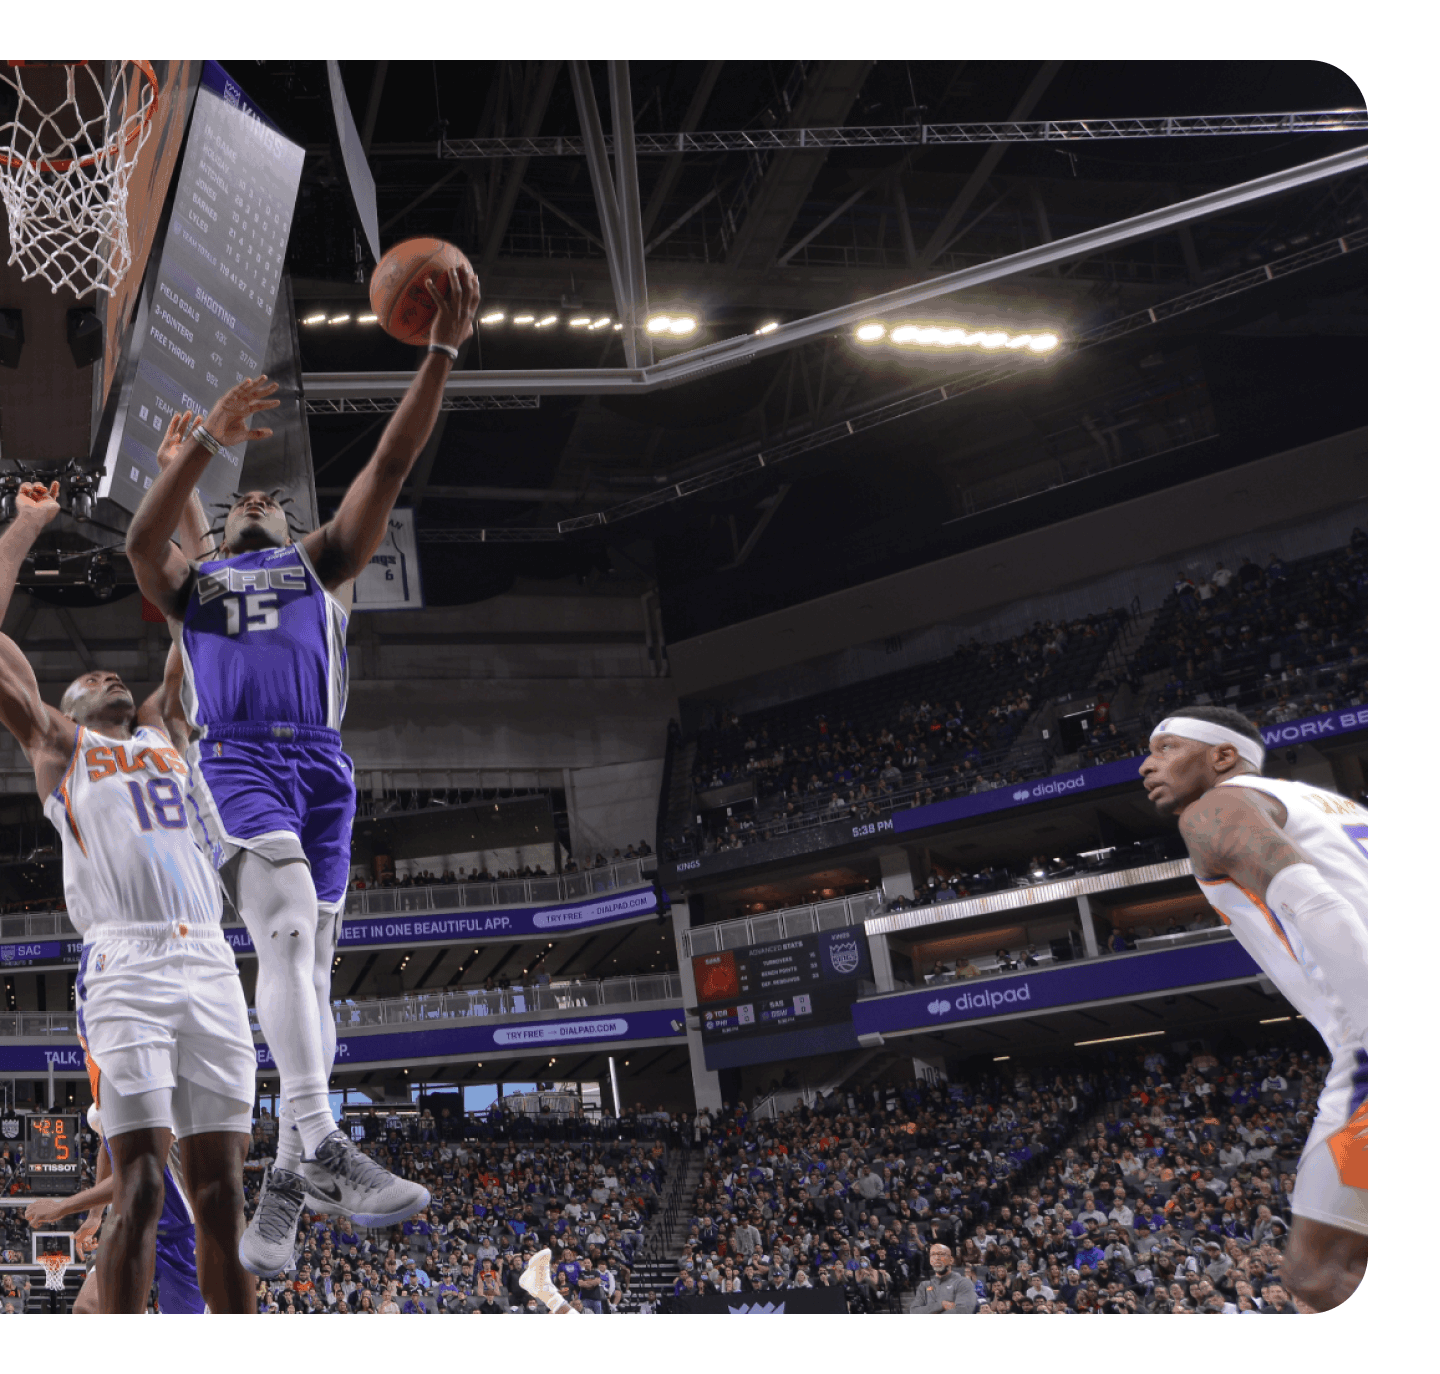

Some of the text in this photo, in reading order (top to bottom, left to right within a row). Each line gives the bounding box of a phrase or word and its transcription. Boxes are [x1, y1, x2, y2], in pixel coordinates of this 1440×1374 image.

[160, 282, 178, 305] FIELD
[178, 299, 200, 322] GOALS
[195, 286, 236, 330] SHOOTING
[154, 304, 194, 344] 3-POINTERS
[150, 326, 168, 346] FREE
[168, 339, 196, 370] THROWS
[156, 396, 174, 416] TEAM
[198, 565, 307, 606] SAC
[385, 568, 394, 581] 6
[224, 592, 280, 635] 15
[1260, 717, 1336, 746] WORK
[1032, 774, 1085, 798] dialpad
[126, 778, 188, 832] 18
[852, 819, 894, 838] 5:38 PM
[676, 859, 701, 872] KINGS
[546, 897, 648, 924] TRY FREE DIALPAD.COM
[370, 924, 384, 938] IN
[386, 922, 412, 938] ONE
[414, 918, 484, 935] BEAUTIFUL
[484, 916, 513, 931] APP.
[18, 944, 42, 956] SAC
[956, 982, 1031, 1012] dialpad
[506, 1022, 617, 1040] TRY FREE DIALPAD.COM
[44, 1050, 81, 1066] TALK,
[54, 1134, 70, 1160] 5
[42, 1163, 78, 1172] TISSOT
